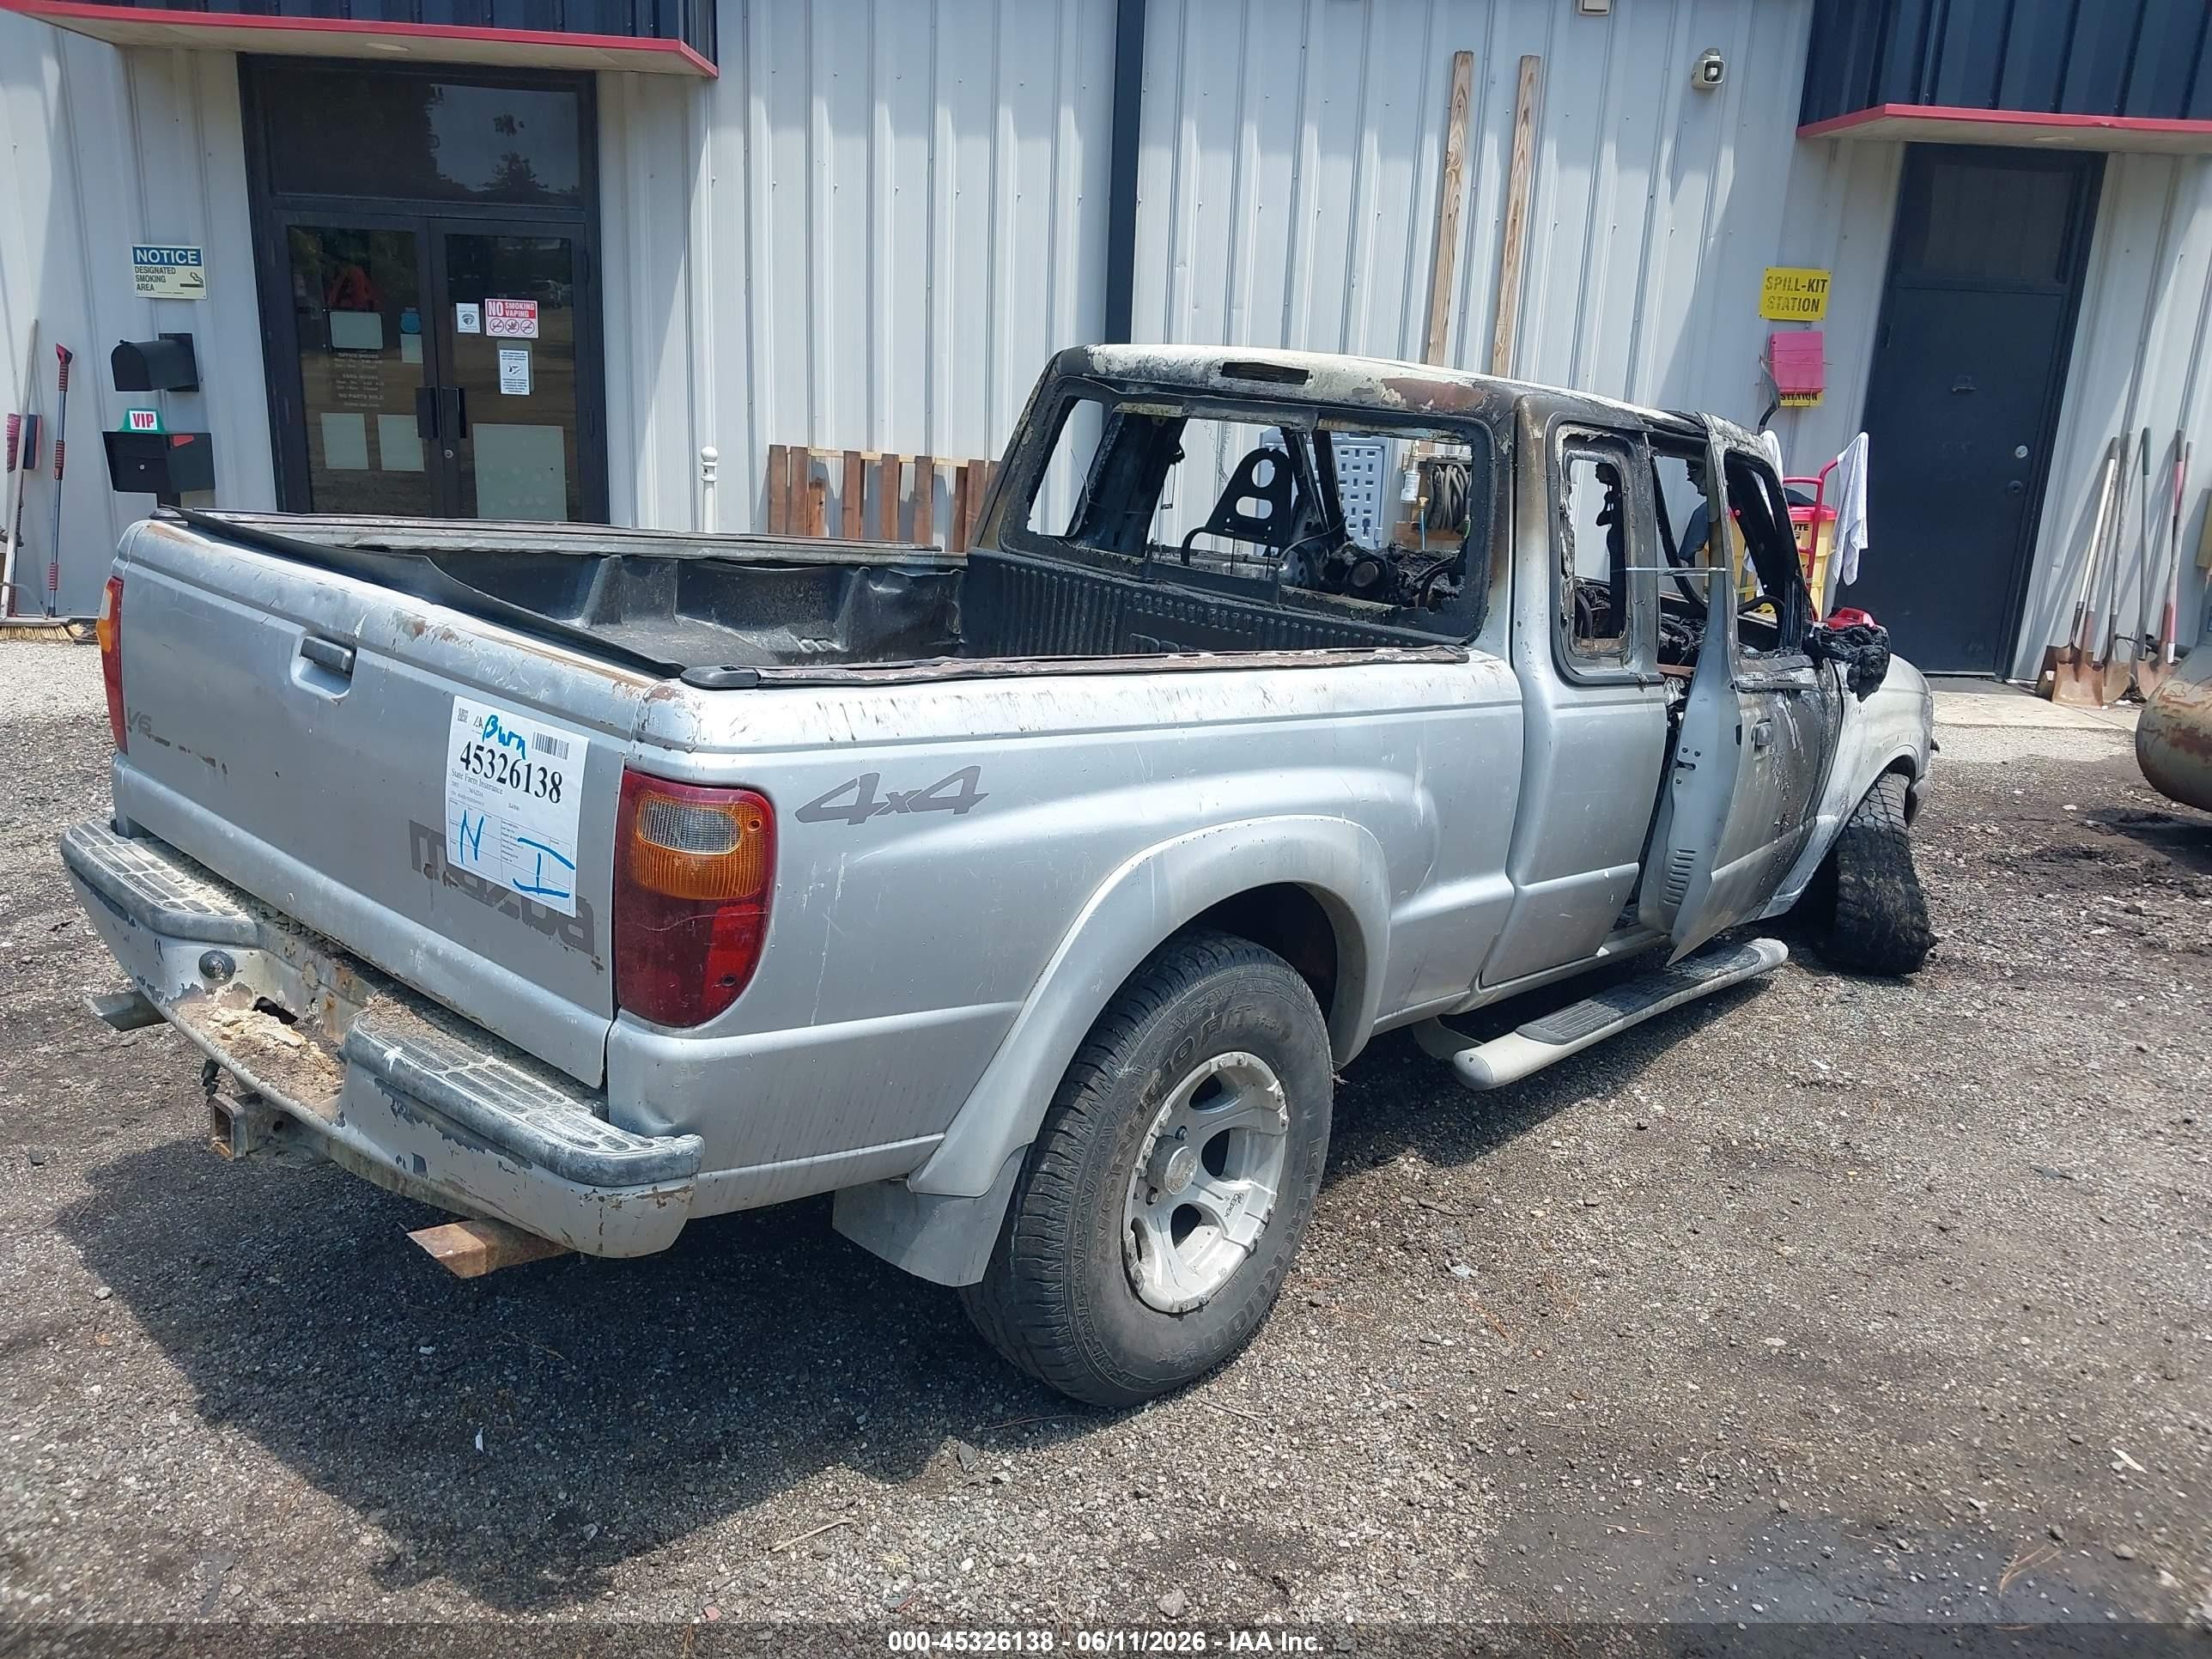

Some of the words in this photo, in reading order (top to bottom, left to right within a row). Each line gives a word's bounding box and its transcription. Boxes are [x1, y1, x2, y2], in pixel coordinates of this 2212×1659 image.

[136, 249, 198, 264] NOTICE
[134, 266, 177, 275] DESIGNATED
[136, 275, 167, 283] SMOKING
[1765, 276, 1828, 294] SPILL-KIT
[488, 301, 504, 317] NO
[1766, 295, 1820, 313] STATION
[506, 309, 530, 318] VAPING
[132, 413, 155, 428] VIP
[127, 707, 151, 732] V6
[460, 740, 563, 805] 45326138
[451, 768, 465, 780] State
[465, 773, 478, 785] Farm
[478, 778, 504, 796] Insurance
[794, 764, 990, 826] 4x4
